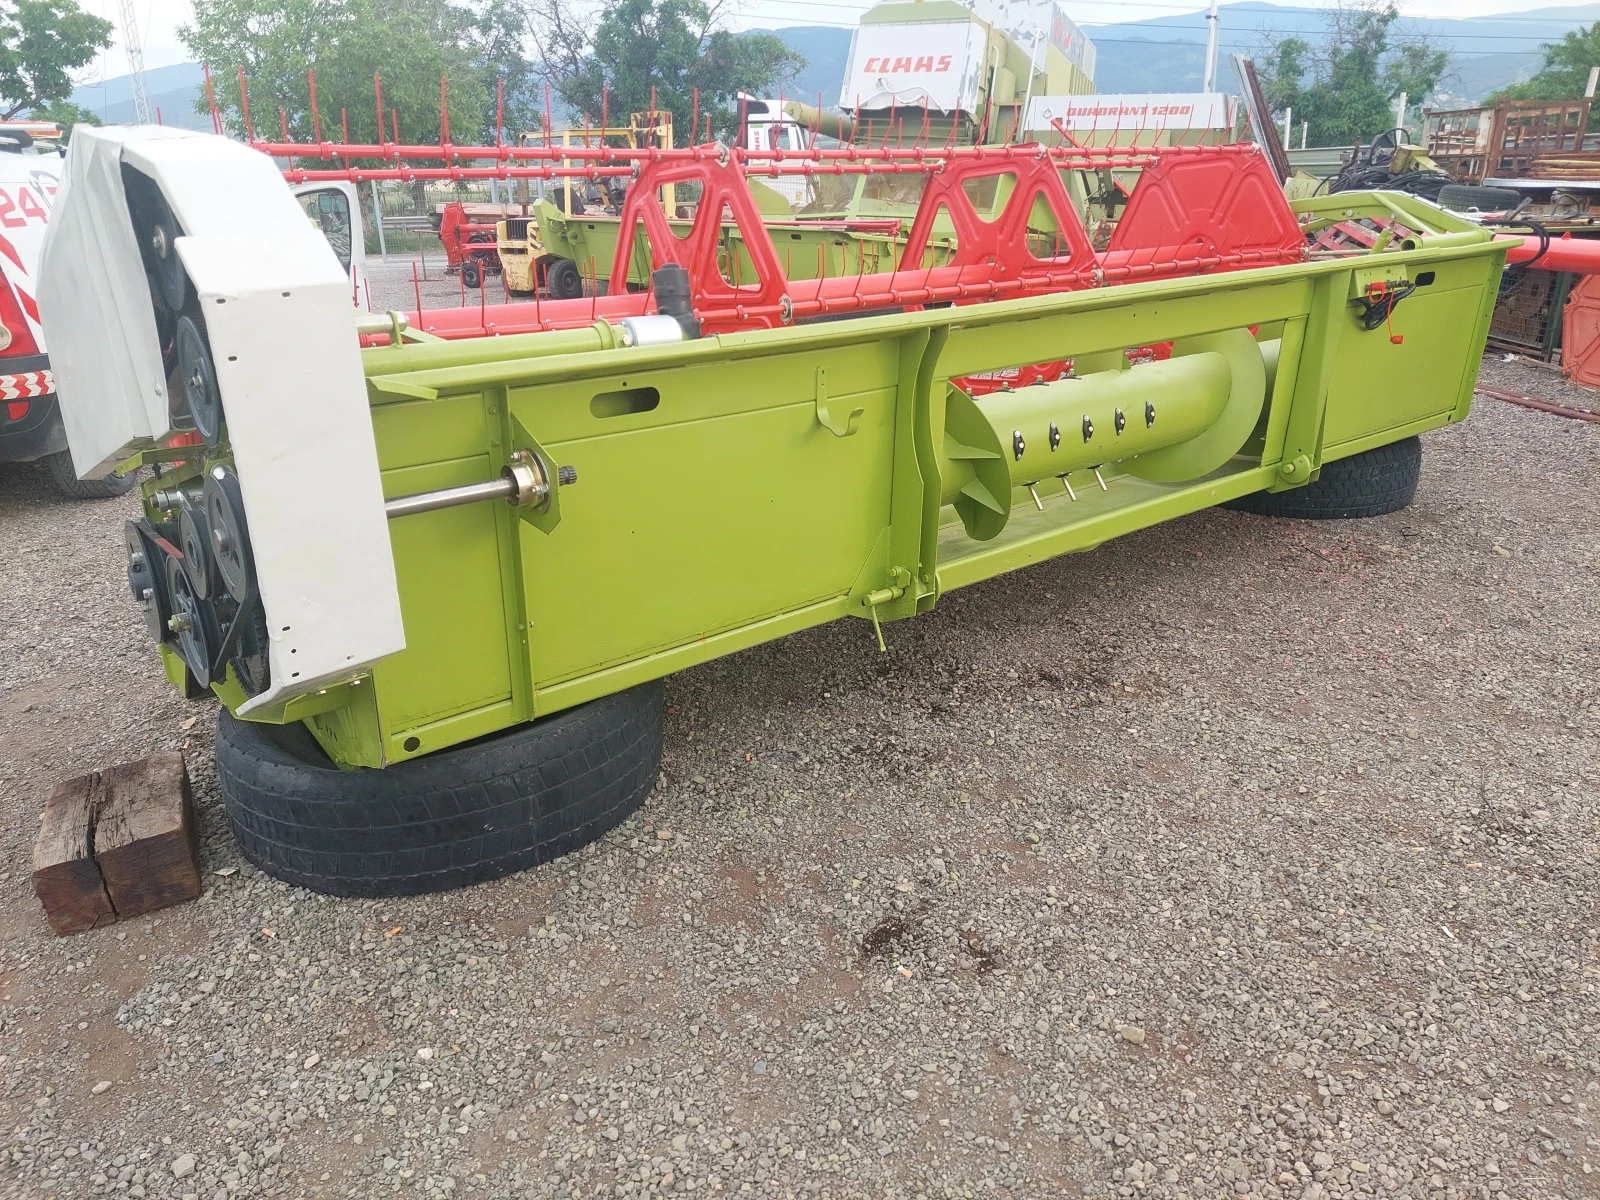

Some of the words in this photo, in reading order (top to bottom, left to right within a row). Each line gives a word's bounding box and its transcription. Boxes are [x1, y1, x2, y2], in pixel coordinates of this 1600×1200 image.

[863, 55, 952, 73] CLAAS
[1066, 106, 1148, 117] QUADRANT
[1151, 105, 1191, 116] 1200
